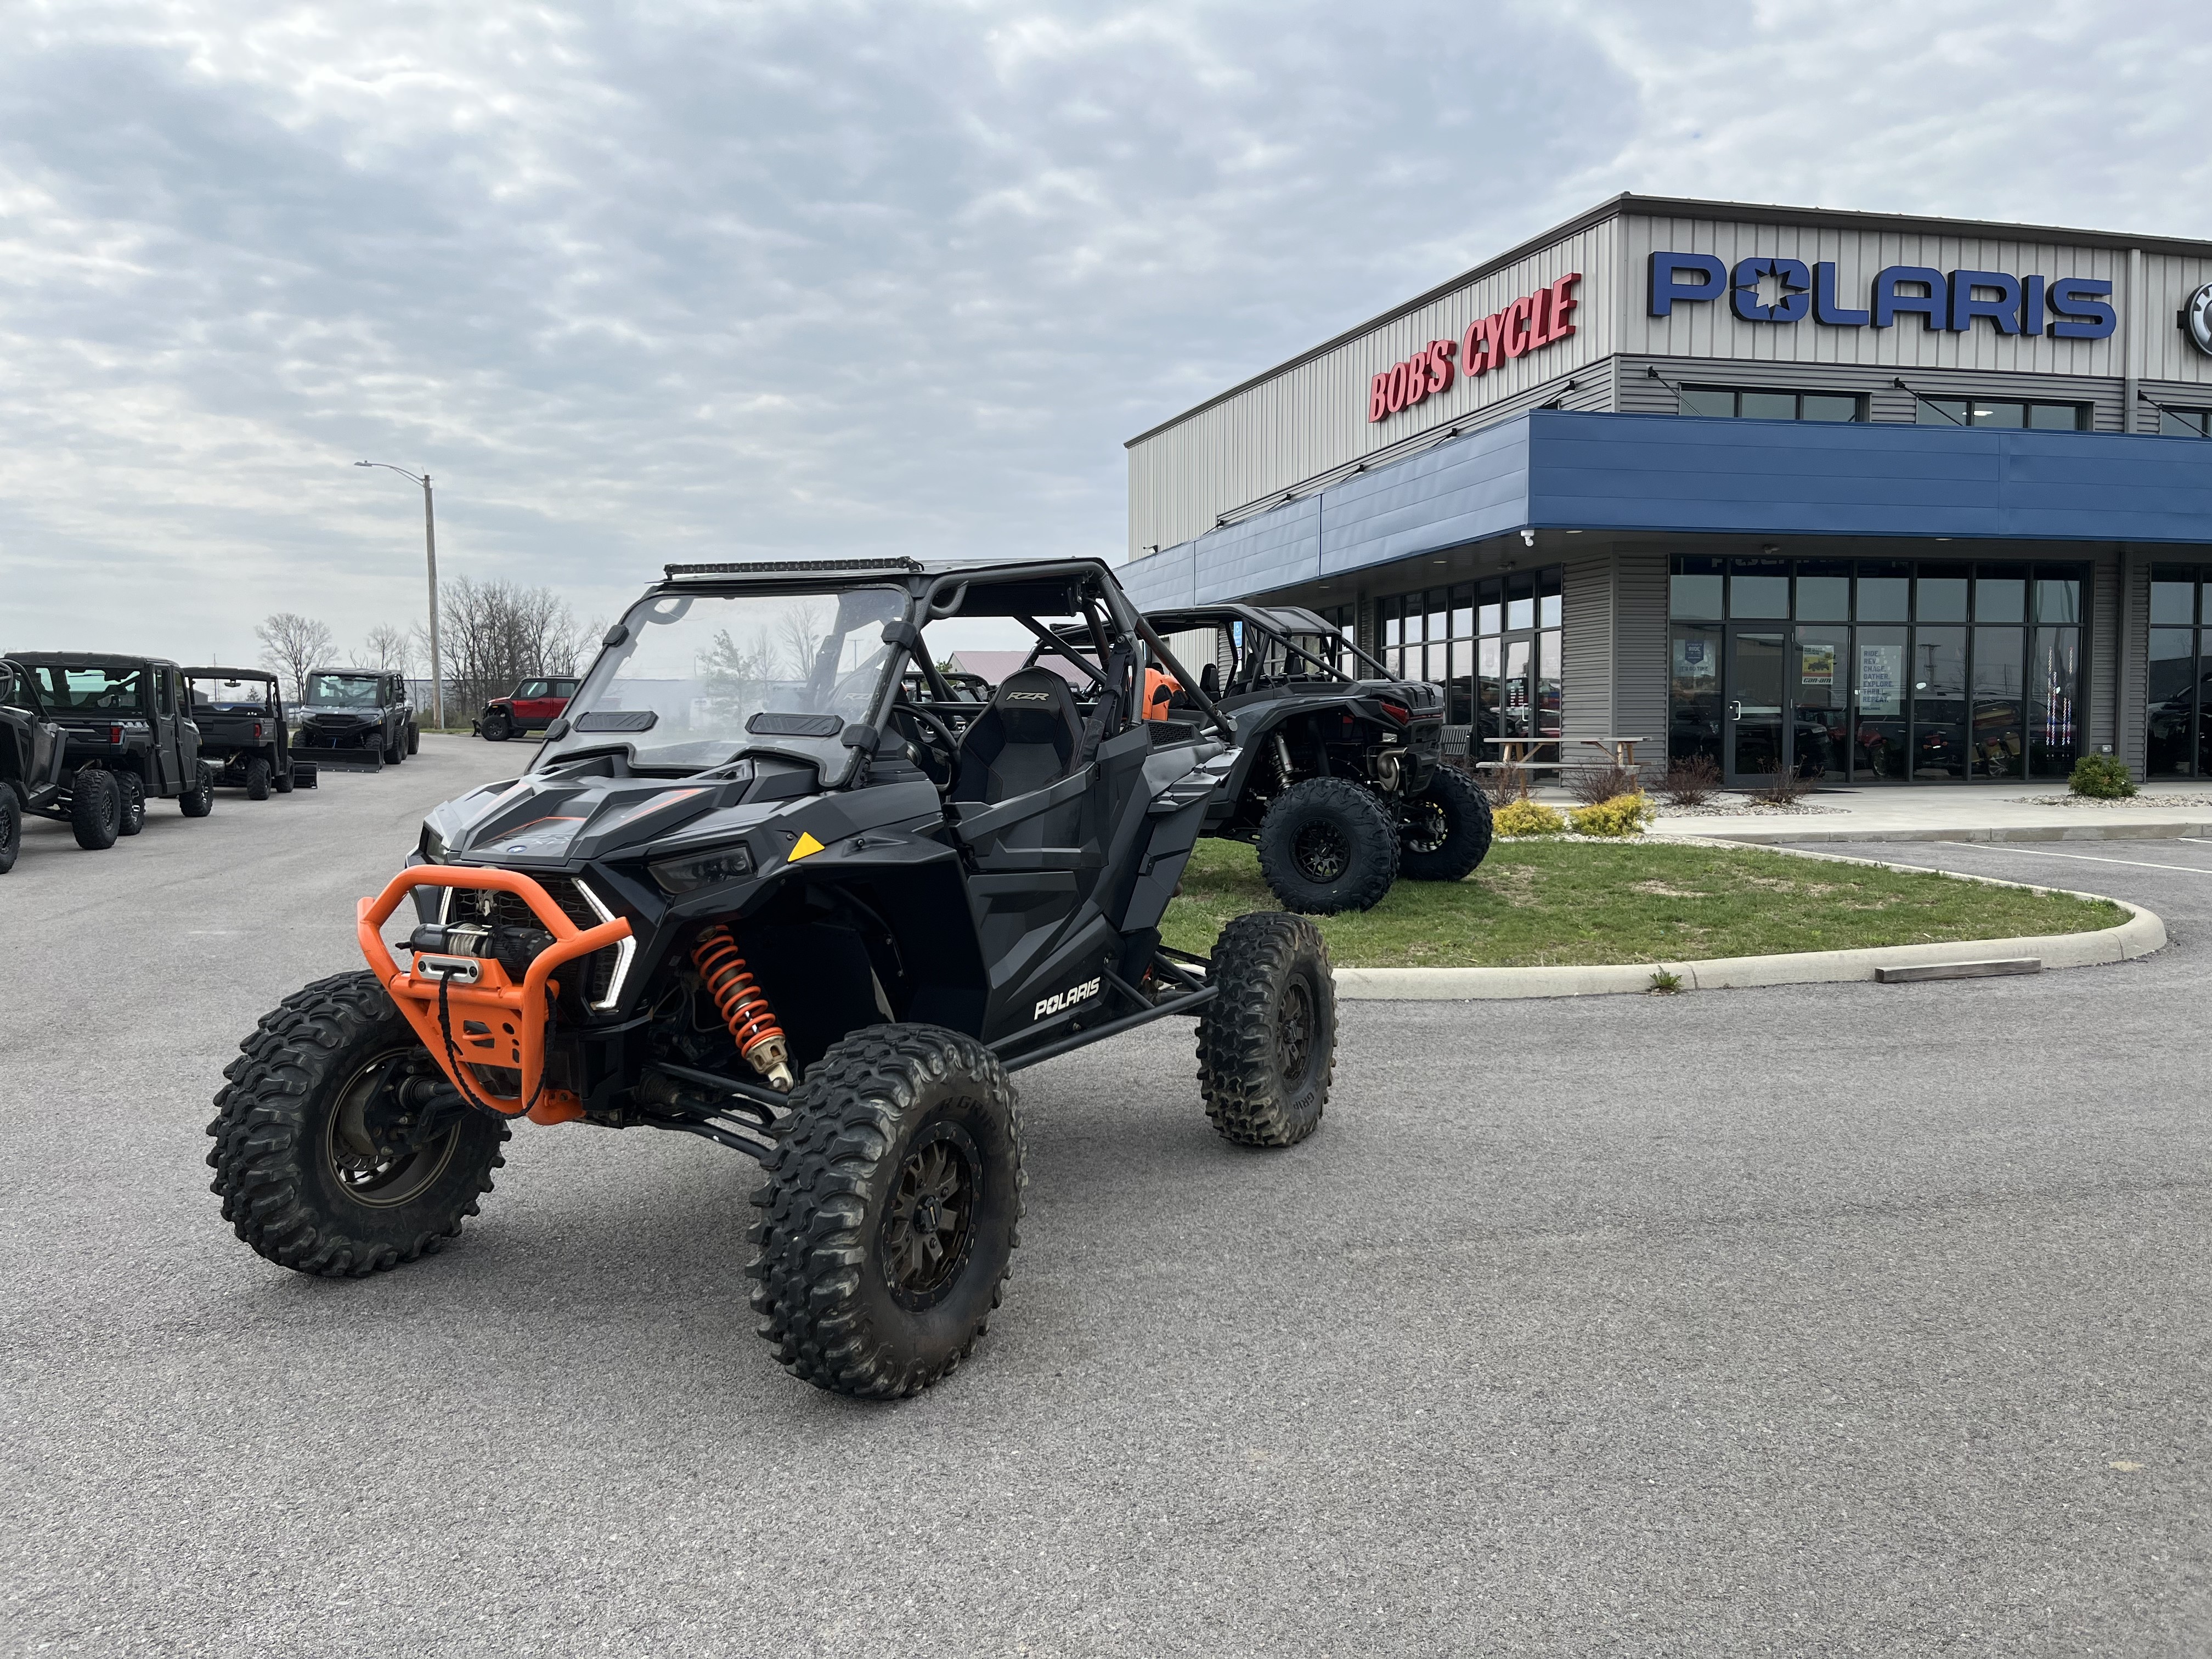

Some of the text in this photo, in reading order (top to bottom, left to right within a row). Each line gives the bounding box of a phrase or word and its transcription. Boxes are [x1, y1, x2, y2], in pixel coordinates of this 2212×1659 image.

[1647, 251, 2117, 340] POLARIS
[1369, 272, 1581, 423] BOB'S CYCLE
[1006, 692, 1049, 701] RZR
[1034, 977, 1101, 1020] POLARIS
[957, 1095, 997, 1131] GRIP
[1293, 1091, 1315, 1110] GRIP
